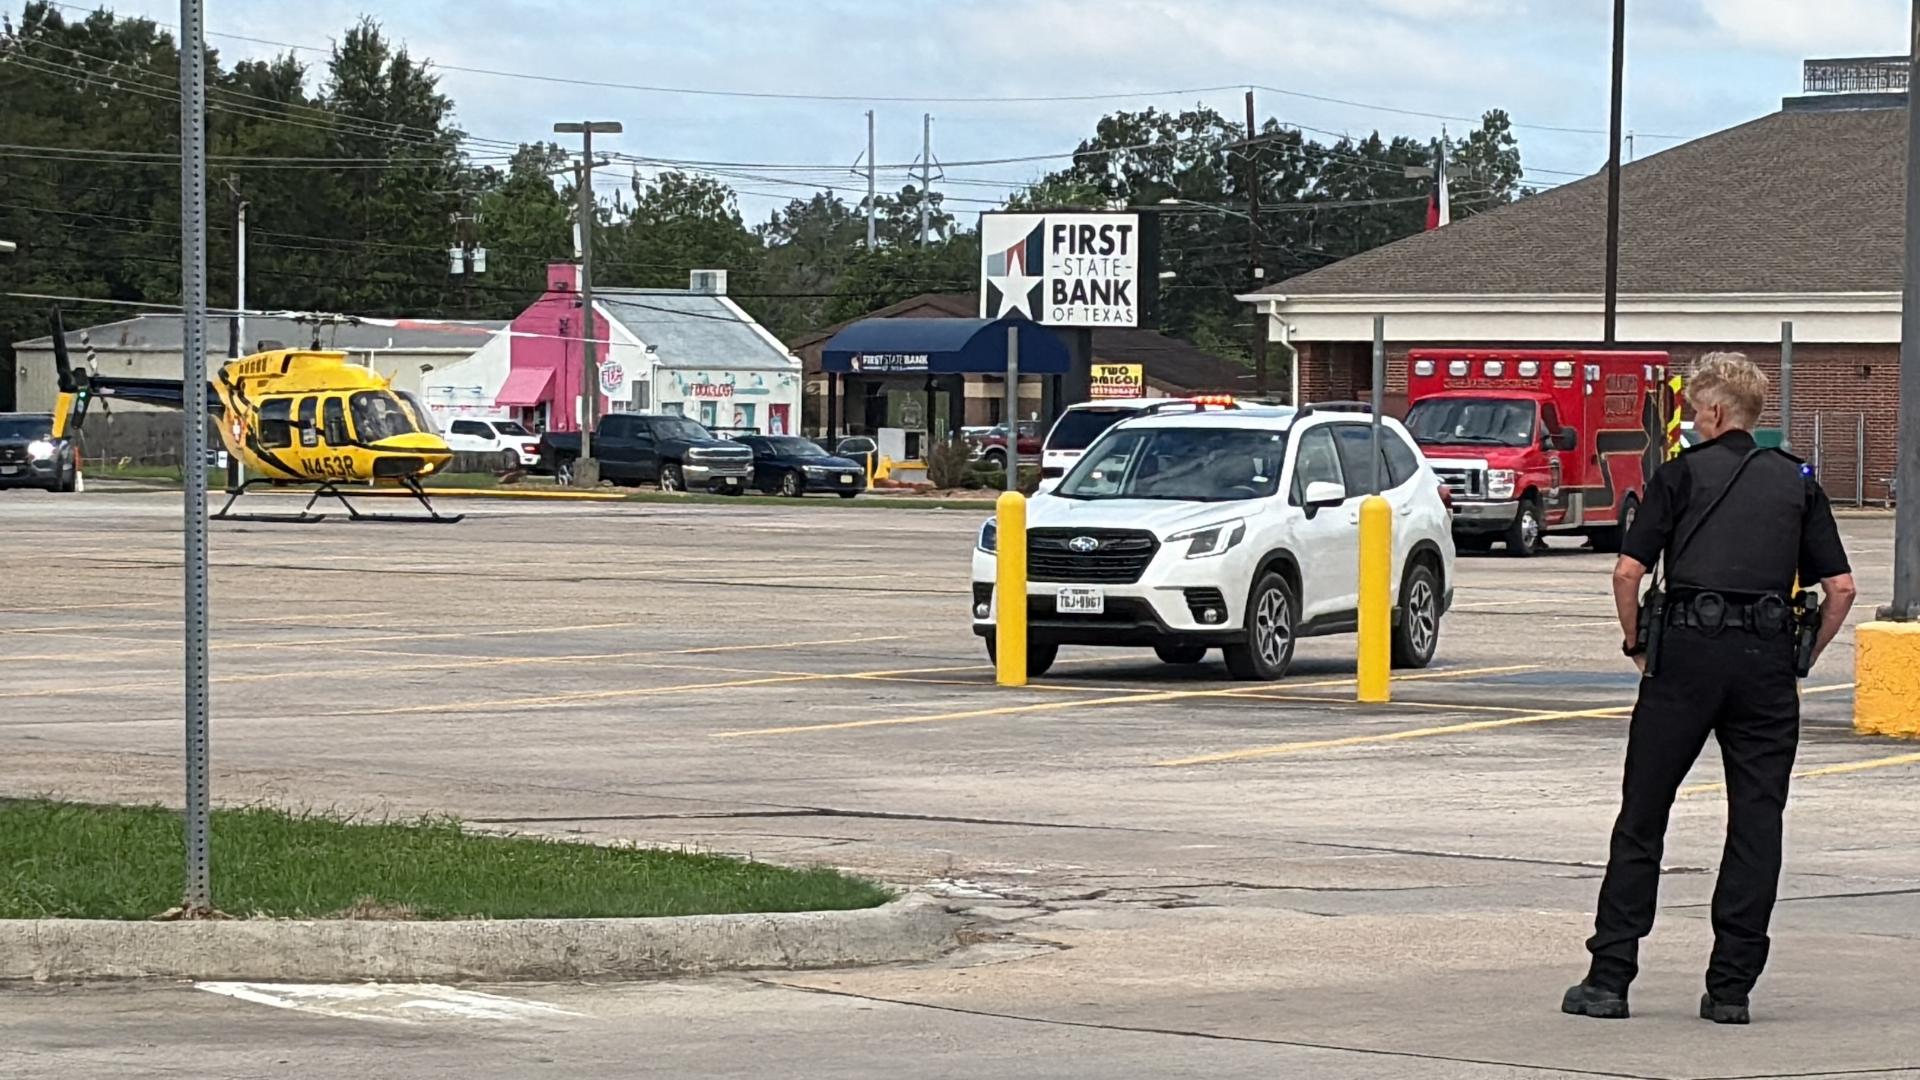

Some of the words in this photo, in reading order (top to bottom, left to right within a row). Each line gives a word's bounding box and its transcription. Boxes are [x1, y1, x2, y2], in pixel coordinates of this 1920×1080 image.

[1052, 224, 1133, 256] FIRST
[1052, 278, 1132, 306] BANK
[1052, 307, 1074, 322] OF
[1084, 308, 1134, 323] TEXAS
[863, 355, 883, 365] FIRST
[903, 354, 928, 365] BANK
[1100, 366, 1129, 376] TWO
[301, 455, 357, 477] N453R
